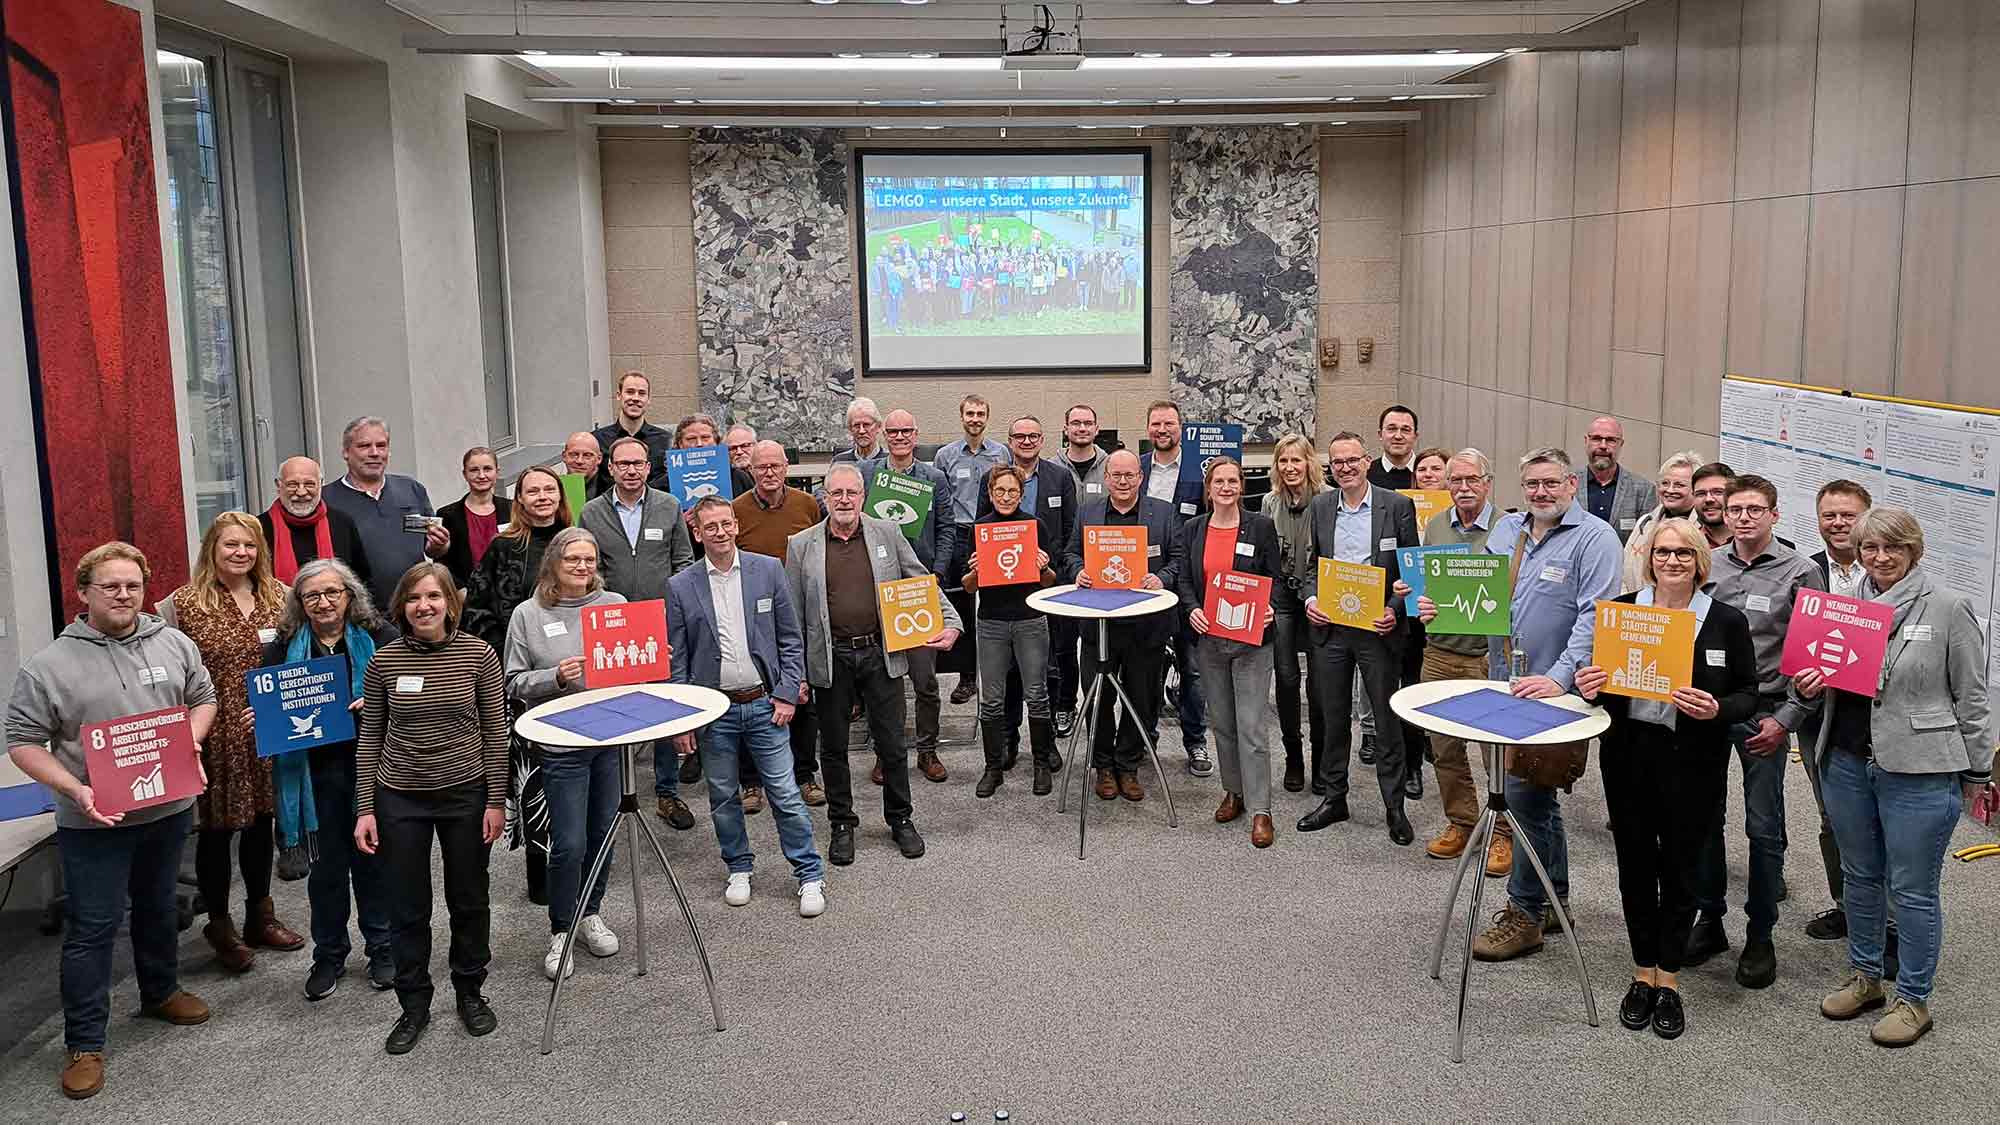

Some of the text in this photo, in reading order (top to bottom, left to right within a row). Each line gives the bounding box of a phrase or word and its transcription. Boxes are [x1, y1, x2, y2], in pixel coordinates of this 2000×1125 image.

[875, 193, 925, 208] LEMGO
[942, 195, 986, 207] unsere
[989, 193, 1028, 208] Stadt,
[1031, 194, 1075, 206] unsere
[1079, 192, 1129, 206] Zukunft
[1186, 427, 1197, 440] 17
[671, 453, 683, 468] 14
[876, 472, 889, 488] 13
[980, 527, 988, 543] 5
[1089, 530, 1096, 544] 9
[1403, 552, 1413, 567] 6
[1431, 558, 1441, 576] 3
[1447, 559, 1499, 568] GESUNDHEIT UND
[1323, 562, 1331, 577] 7
[1447, 568, 1493, 577] WOHLERGEHEN
[1213, 572, 1221, 588] 4
[883, 586, 896, 603] 12
[1801, 594, 1821, 616] 10
[1825, 599, 1859, 614] WENIGER
[590, 610, 597, 630] 1
[1602, 607, 1617, 628] 11
[1621, 609, 1672, 624] NACHHALTIGE
[1823, 610, 1883, 631] UNGLEICHHEITEN
[1621, 620, 1665, 634] STÄDTE UND
[1620, 631, 1663, 645] GEMEINDEN
[253, 673, 274, 694] 16
[279, 672, 334, 690] GERECHTIGKEIT
[281, 684, 326, 701] UND STARKE
[282, 692, 336, 711] INSTITUTIONEN
[109, 711, 186, 735] MENSCHENWÜRDIGE
[91, 728, 106, 751] 8
[112, 729, 157, 747] ARBEIT UND
[113, 737, 171, 758] WIRTSCHAFTS-
[115, 750, 161, 769] WACHSTUM
